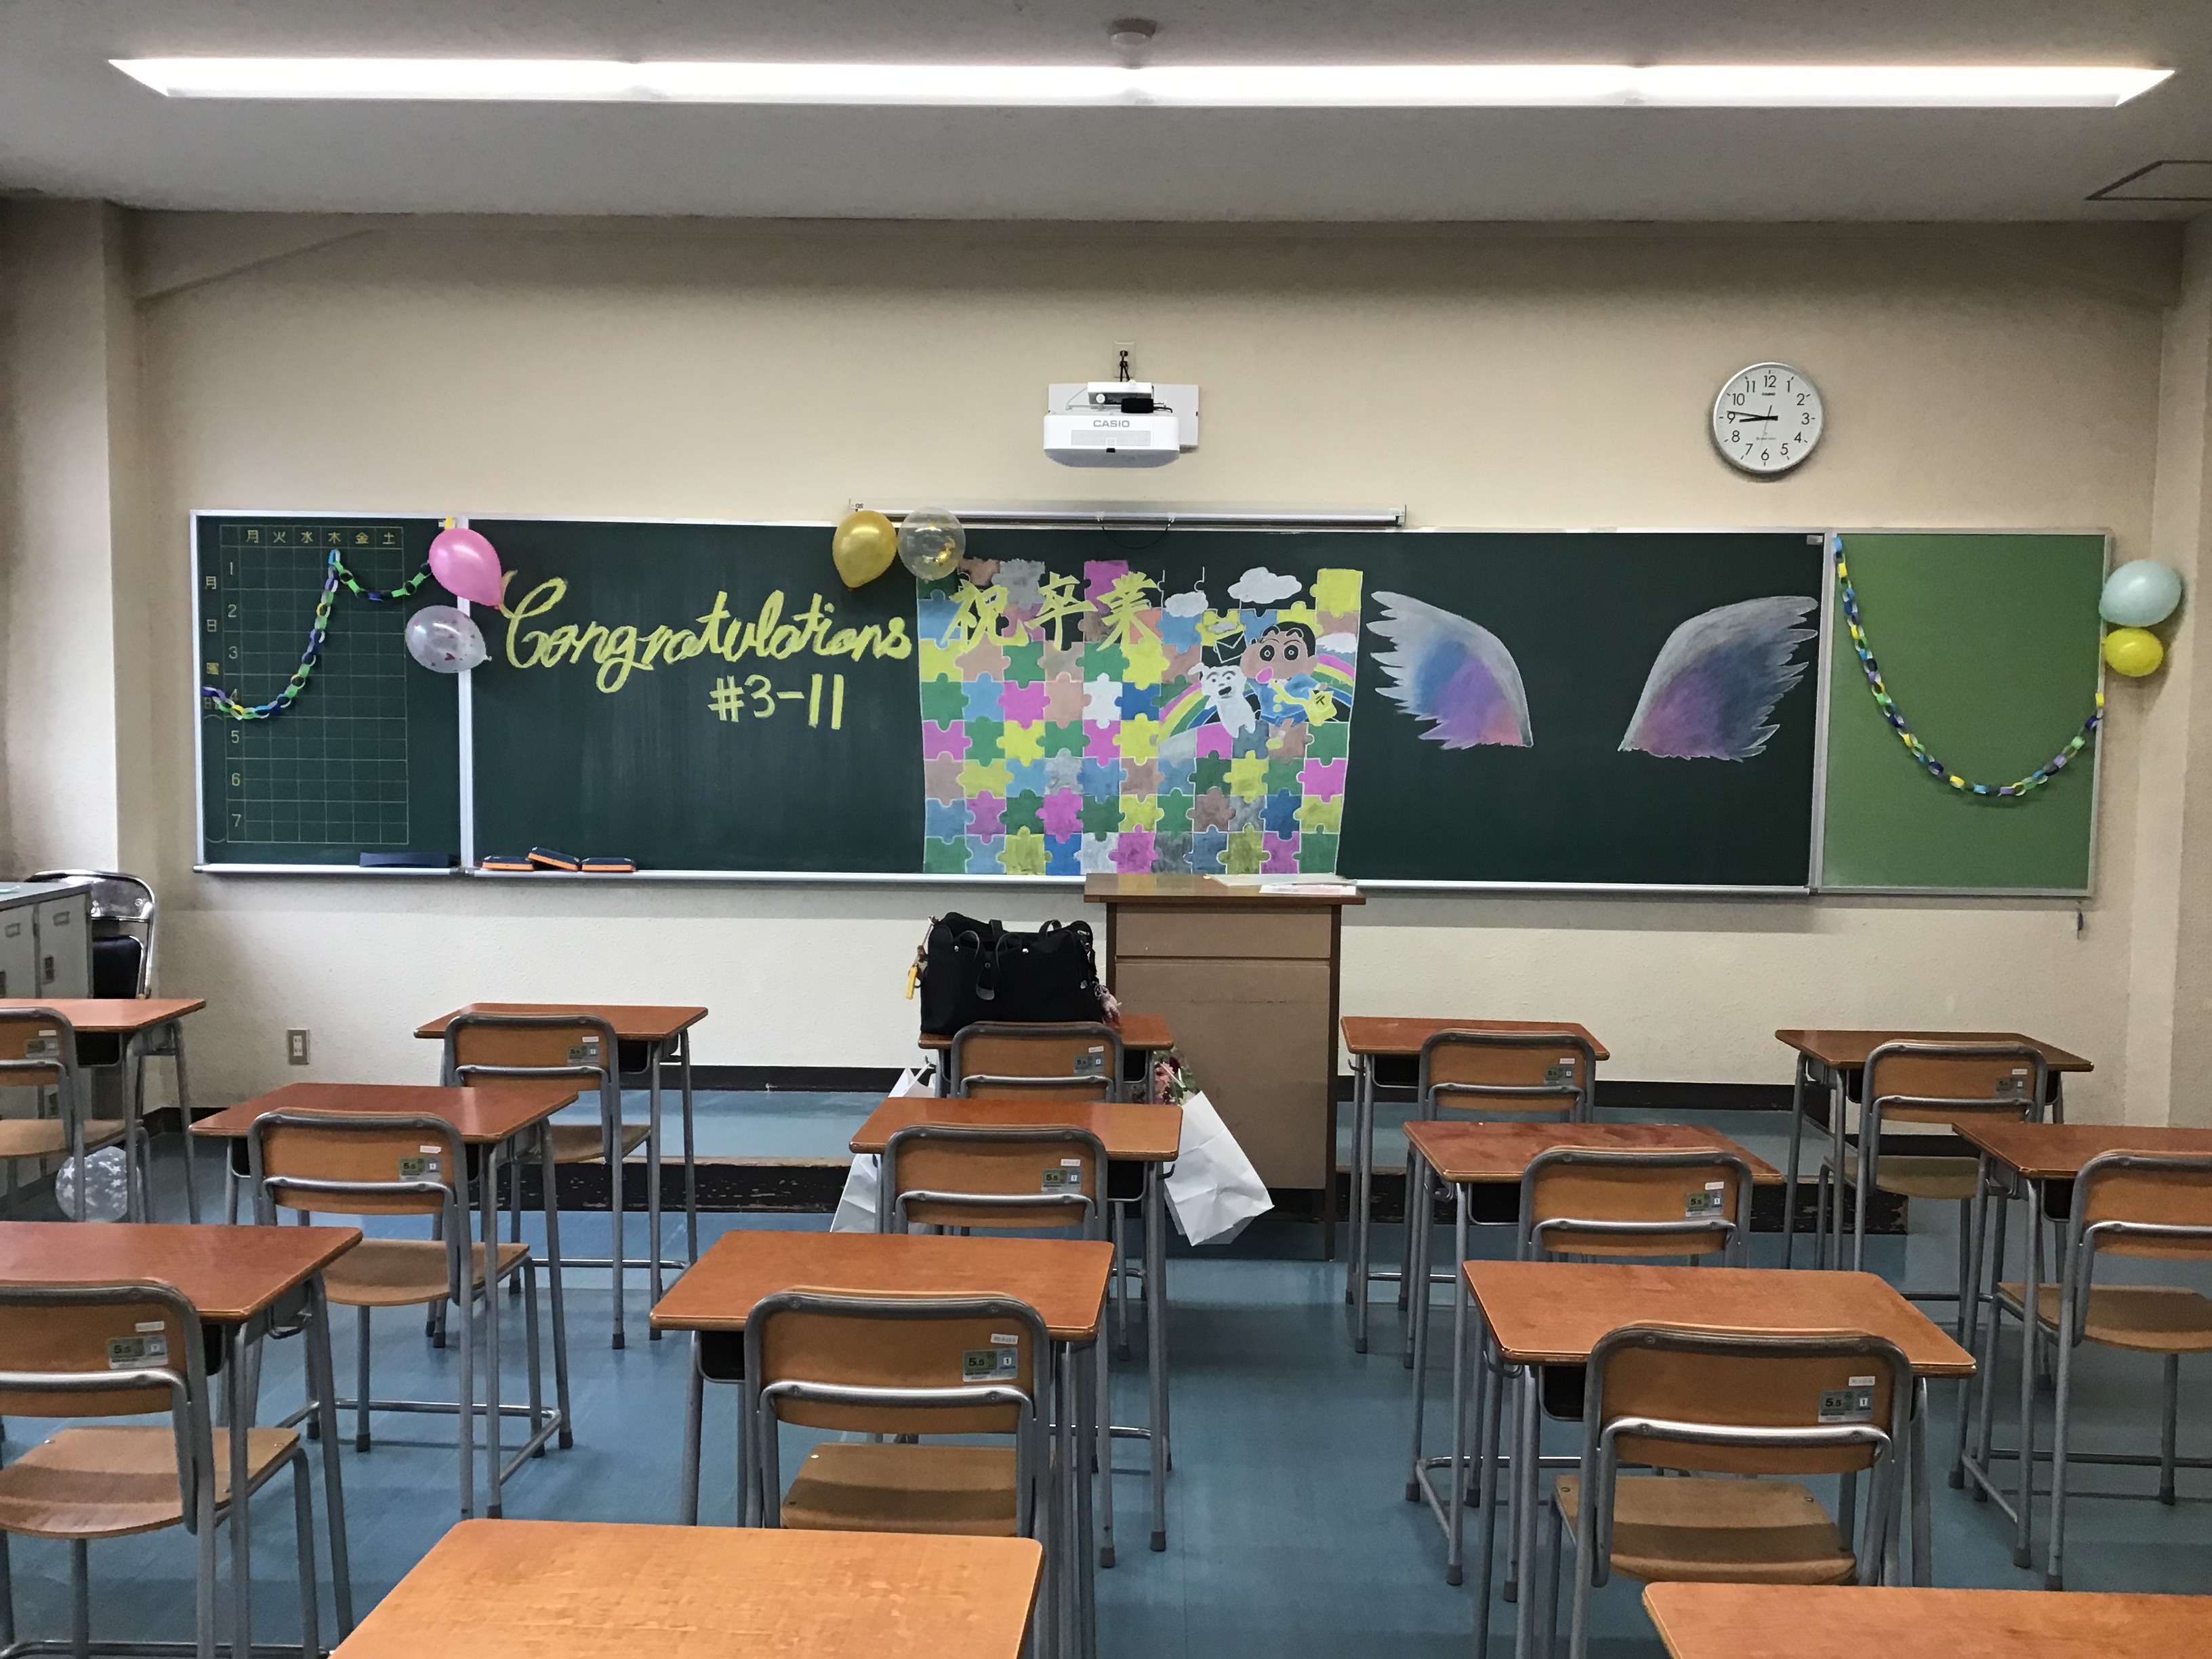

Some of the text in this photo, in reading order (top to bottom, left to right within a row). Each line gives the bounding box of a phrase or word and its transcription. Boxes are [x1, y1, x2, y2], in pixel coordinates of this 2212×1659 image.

[1746, 380, 1755, 393] 11
[1763, 375, 1777, 388] 12
[1786, 380, 1790, 392] 1
[1732, 393, 1745, 405] 10
[1797, 393, 1805, 405] 2
[1093, 419, 1130, 428] CASIO
[1727, 411, 1736, 424] 9
[1801, 412, 1810, 425] 3
[1732, 430, 1740, 443] 8
[1794, 431, 1802, 443] 4
[1746, 443, 1753, 455] 7
[1761, 448, 1769, 461] 6
[1780, 443, 1788, 455] 5
[246, 529, 396, 544] 月 火 水 木 金 土
[205, 576, 218, 632] 月 日
[228, 604, 237, 618] 2
[941, 569, 1159, 653] 祝卒業
[499, 570, 914, 693] Congratulations
[228, 646, 238, 659] 3
[708, 674, 844, 731] #3-11
[231, 730, 239, 743] 5
[231, 773, 241, 786] 6
[231, 813, 241, 827] 7
